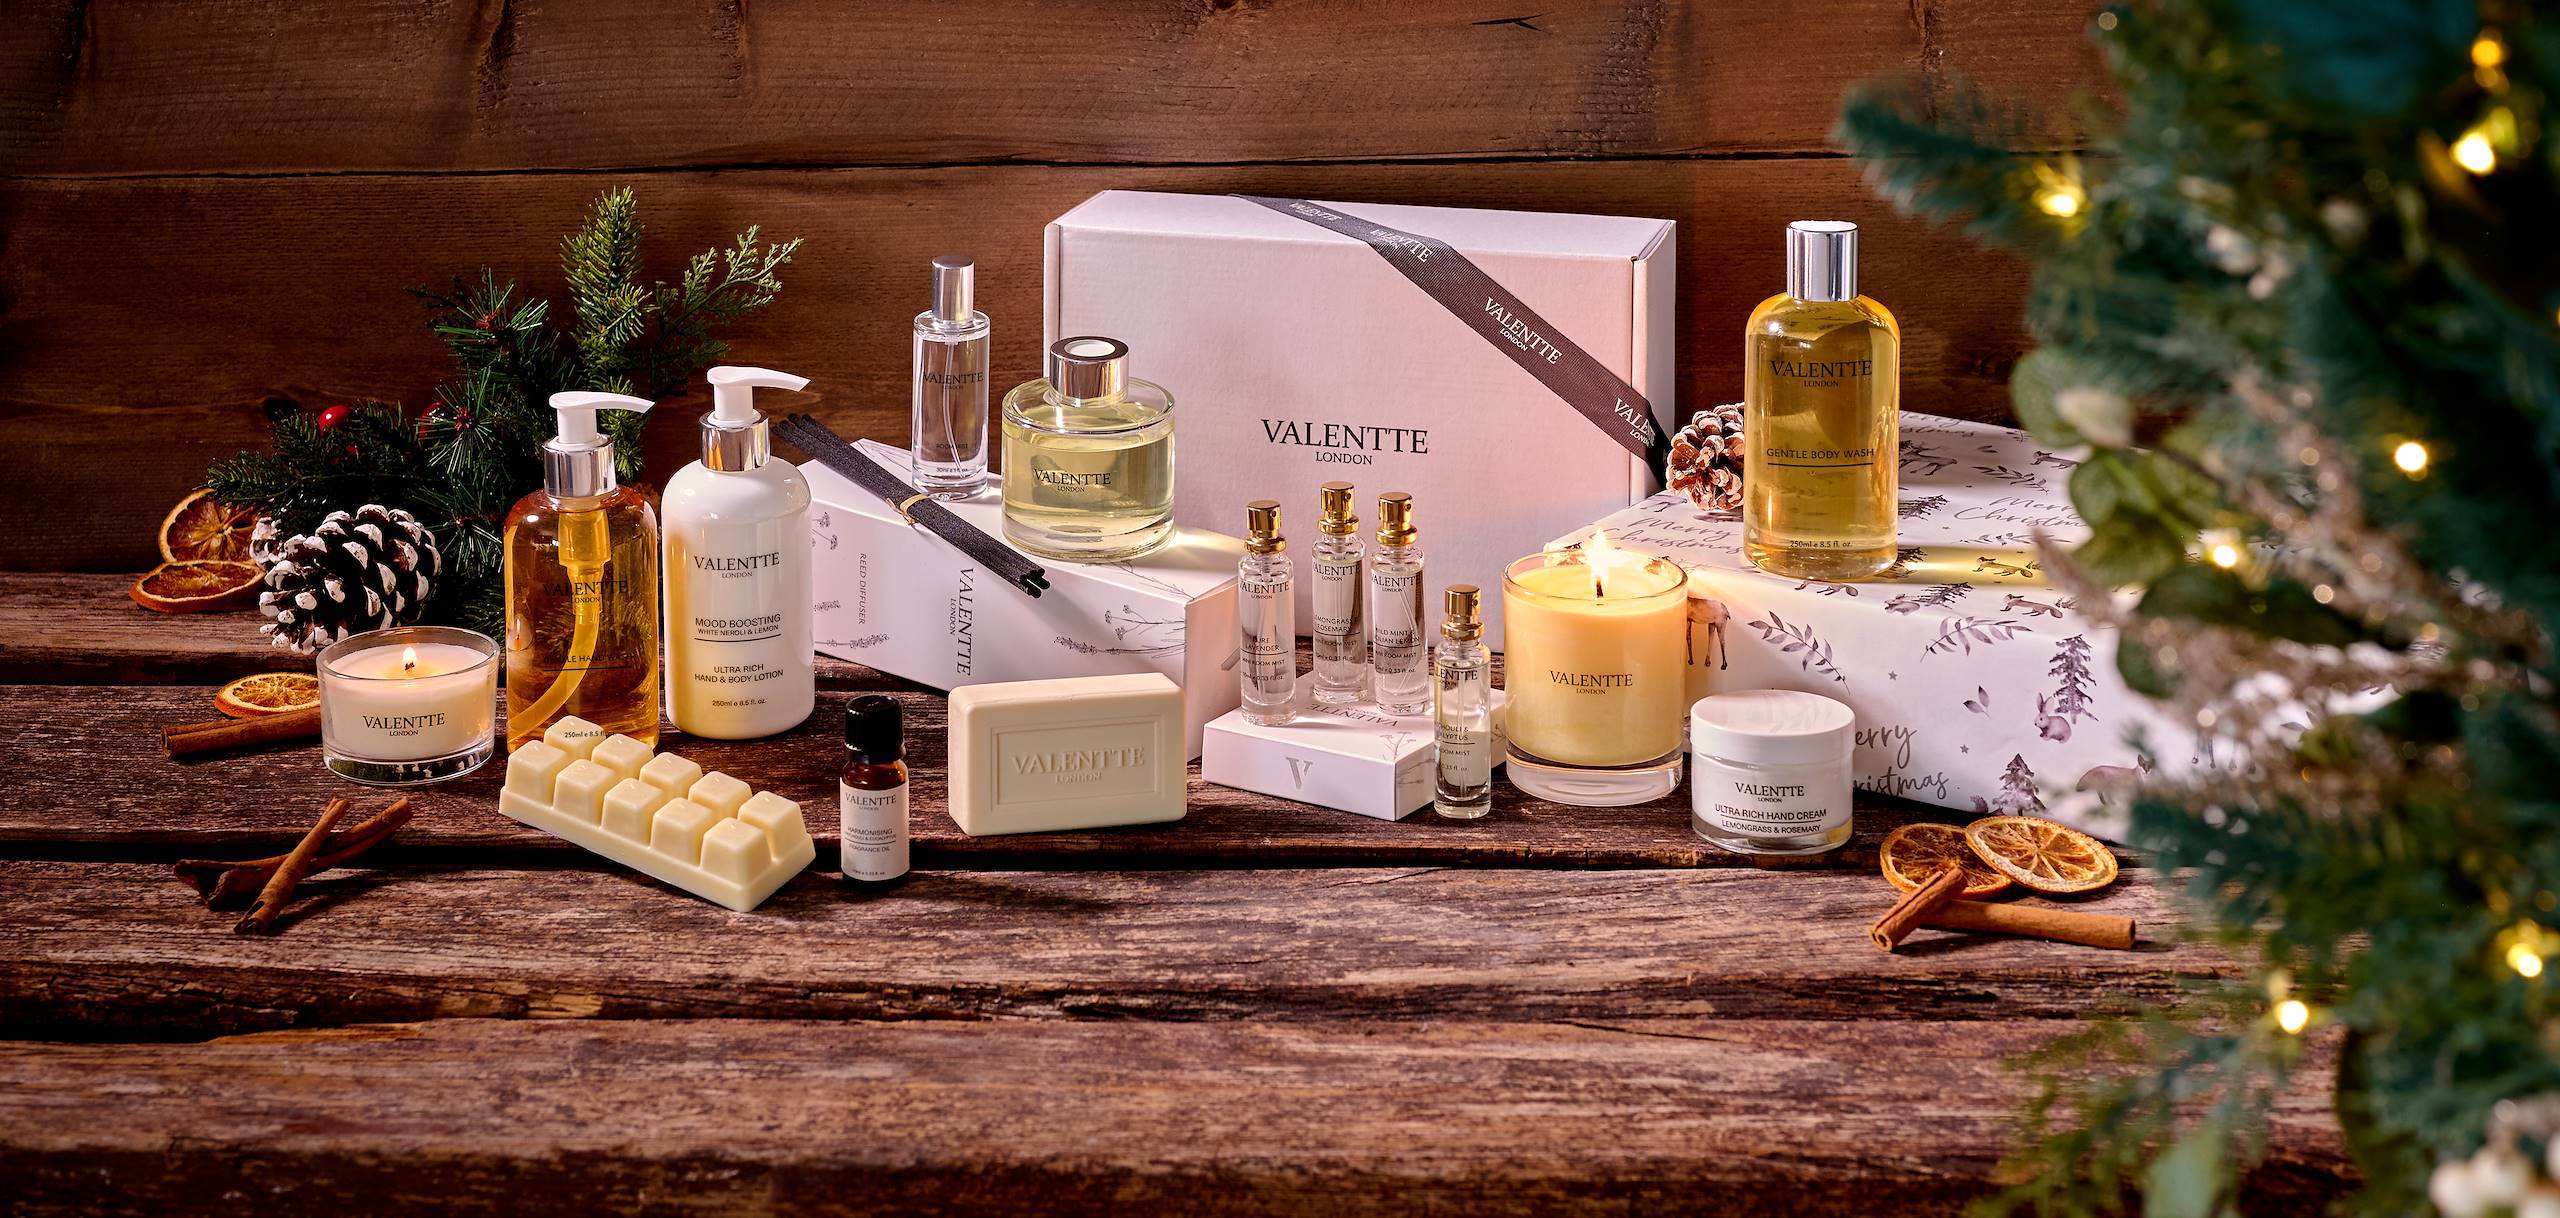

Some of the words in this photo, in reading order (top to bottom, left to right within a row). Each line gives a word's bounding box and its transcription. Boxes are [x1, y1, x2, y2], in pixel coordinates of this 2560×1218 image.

[1485, 296, 1563, 365] VALENTTE
[1500, 327, 1529, 352] LONDON
[1770, 359, 1873, 378] VALENTTE
[923, 371, 984, 385] VALENTTE
[1803, 380, 1839, 388] LONDON
[1261, 418, 1428, 455] VALENTTE
[1315, 451, 1373, 466] LONDON
[1766, 448, 1808, 459] GENTLE
[1811, 450, 1840, 459] BODY
[1843, 448, 1875, 458] WASH
[1034, 467, 1112, 486] VALENTTE
[1057, 485, 1086, 493] LONDON
[693, 551, 780, 571] VALENTTE
[859, 552, 867, 579] REED
[721, 571, 753, 579] LONDON
[858, 579, 867, 625] DIFFUSER
[695, 617, 727, 628] MOOD
[729, 613, 781, 628] BOOSTING
[949, 597, 958, 636] LONDON
[957, 567, 975, 676] VALENTTE
[698, 627, 719, 636] WHITE
[720, 629, 746, 637] NEROLI
[754, 624, 779, 635] LEMON
[694, 673, 718, 683] HAND
[719, 676, 726, 684] &
[728, 675, 752, 684] BODY
[754, 669, 784, 682] LOTION
[713, 665, 741, 674] ULTRA
[743, 664, 764, 673] RICH
[1549, 670, 1633, 687] VALENTTE
[362, 712, 445, 729] VALENTTE
[1854, 724, 1918, 769] erry
[1011, 745, 1146, 774] VALENTTE
[1286, 756, 1314, 790] V
[1735, 782, 1804, 797] VALENTTE
[845, 793, 897, 806] VALENTTE
[1715, 803, 1740, 816] ULTRA
[1742, 809, 1764, 819] RICH
[1766, 812, 1795, 821] HAND
[1796, 808, 1827, 820] CREAM
[1721, 819, 1772, 833] LEMONGRASS
[1781, 824, 1821, 834] ROSEMARY
